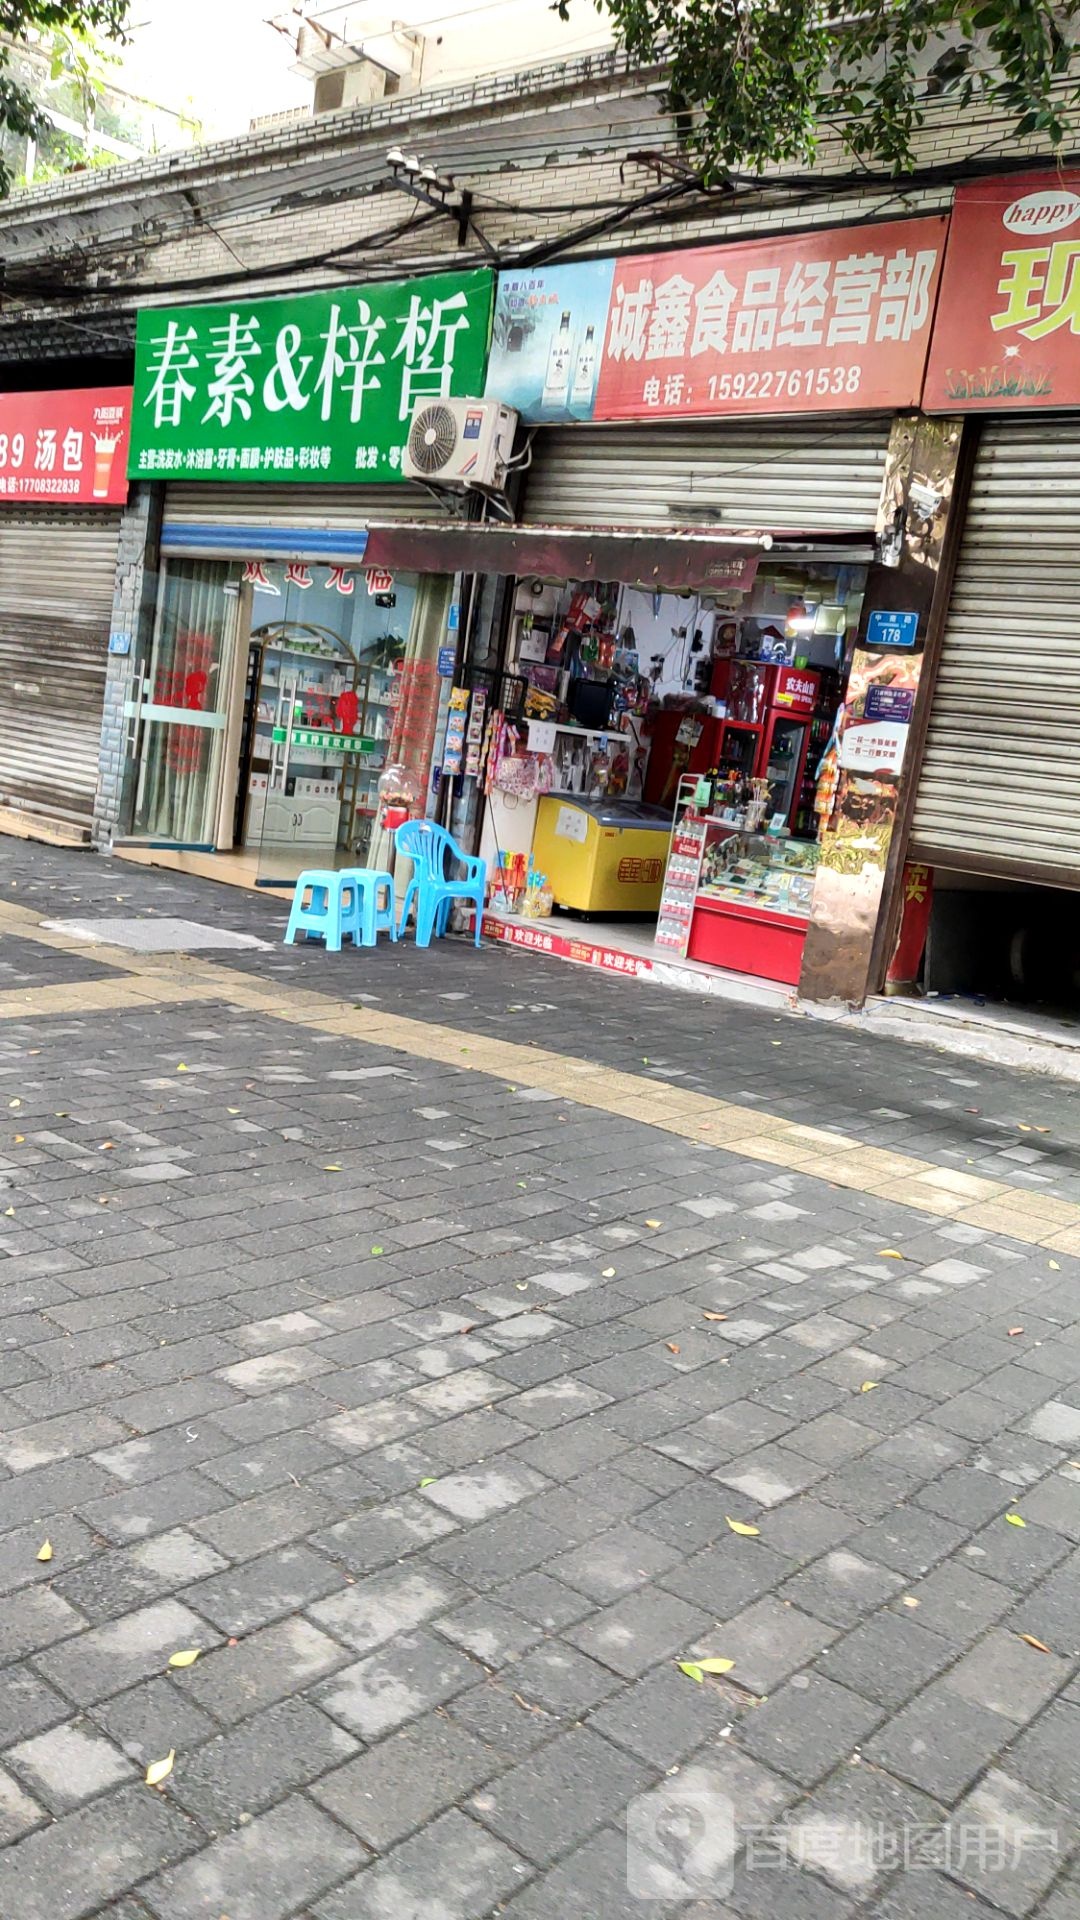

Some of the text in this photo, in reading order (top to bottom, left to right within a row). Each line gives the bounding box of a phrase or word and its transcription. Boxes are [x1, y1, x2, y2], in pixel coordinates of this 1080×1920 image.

[1006, 202, 1080, 226] happy
[990, 239, 1080, 341] 现
[607, 248, 938, 363] 诚鑫食品经营部
[882, 628, 901, 642] 178
[514, 926, 553, 950] 欢迎光临
